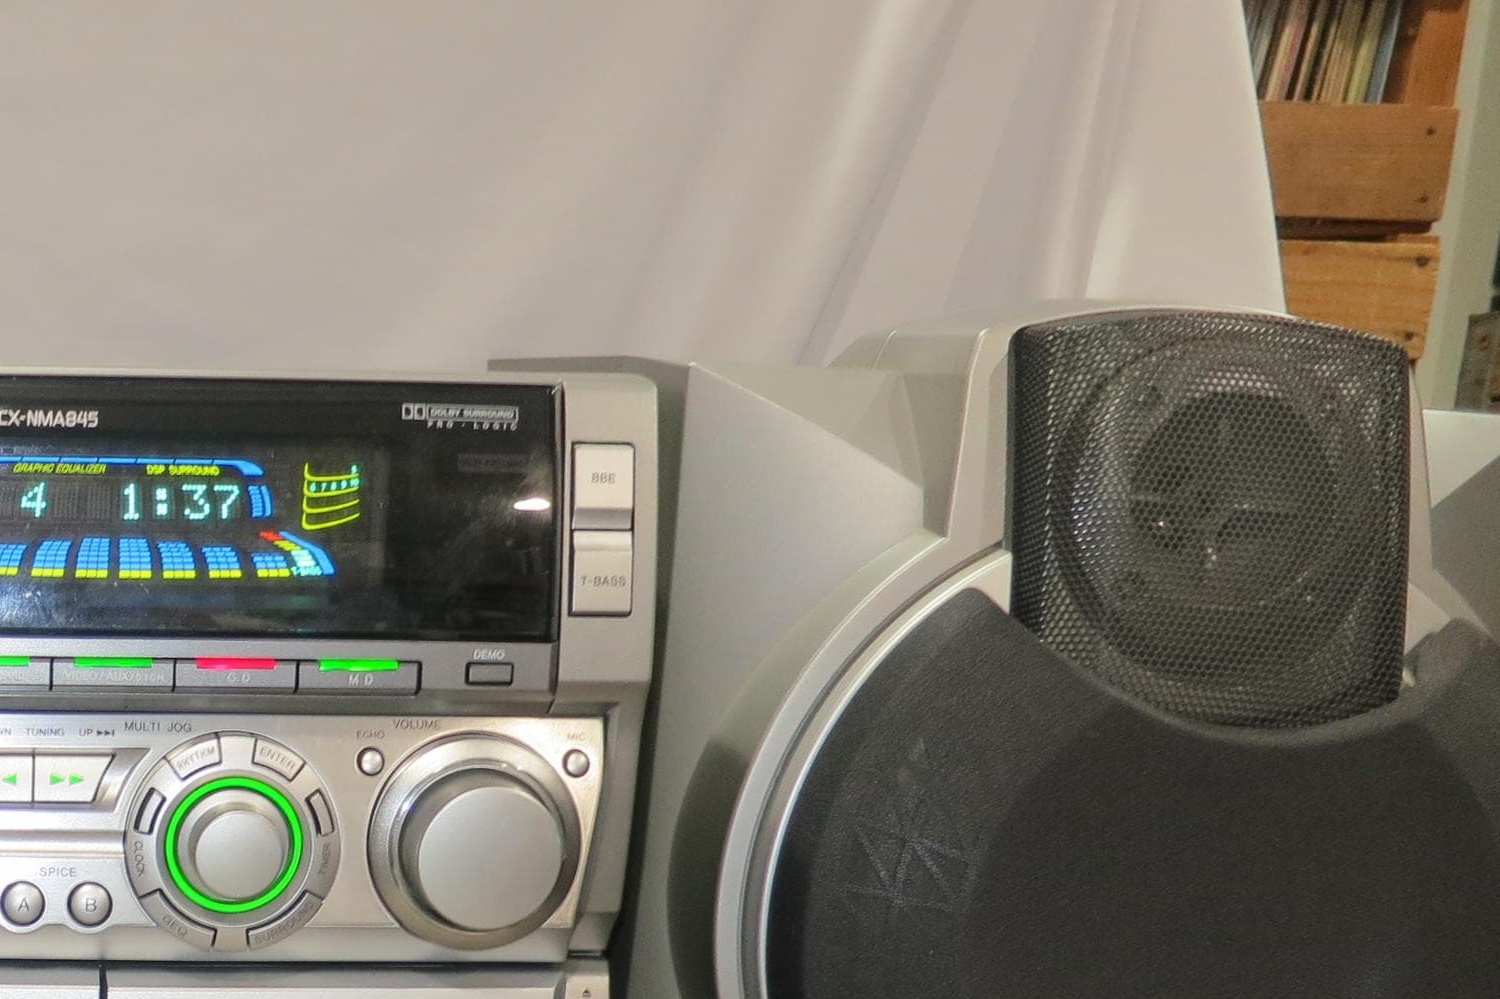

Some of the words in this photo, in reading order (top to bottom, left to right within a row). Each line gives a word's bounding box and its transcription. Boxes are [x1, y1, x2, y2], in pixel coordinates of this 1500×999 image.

[13, 463, 53, 474] GRAPHIC
[55, 464, 107, 475] EQUALIZER
[146, 464, 166, 475] DSP
[168, 464, 221, 476] SURROUND
[591, 472, 616, 484] BBE
[20, 481, 47, 518] 4
[580, 575, 627, 588] T-BASS
[473, 649, 506, 661] DEMO
[124, 721, 161, 733] MULTI
[167, 721, 193, 733] JOG
[392, 718, 443, 730] VOLUME
[26, 727, 66, 738] TUNING
[78, 728, 95, 738] UP
[355, 729, 386, 740] ECHO
[566, 732, 588, 742] MIC
[260, 746, 297, 771] ENTER
[133, 840, 147, 878] CLOCK
[39, 866, 78, 878] SPICE
[17, 897, 31, 913] A
[85, 898, 98, 913] B
